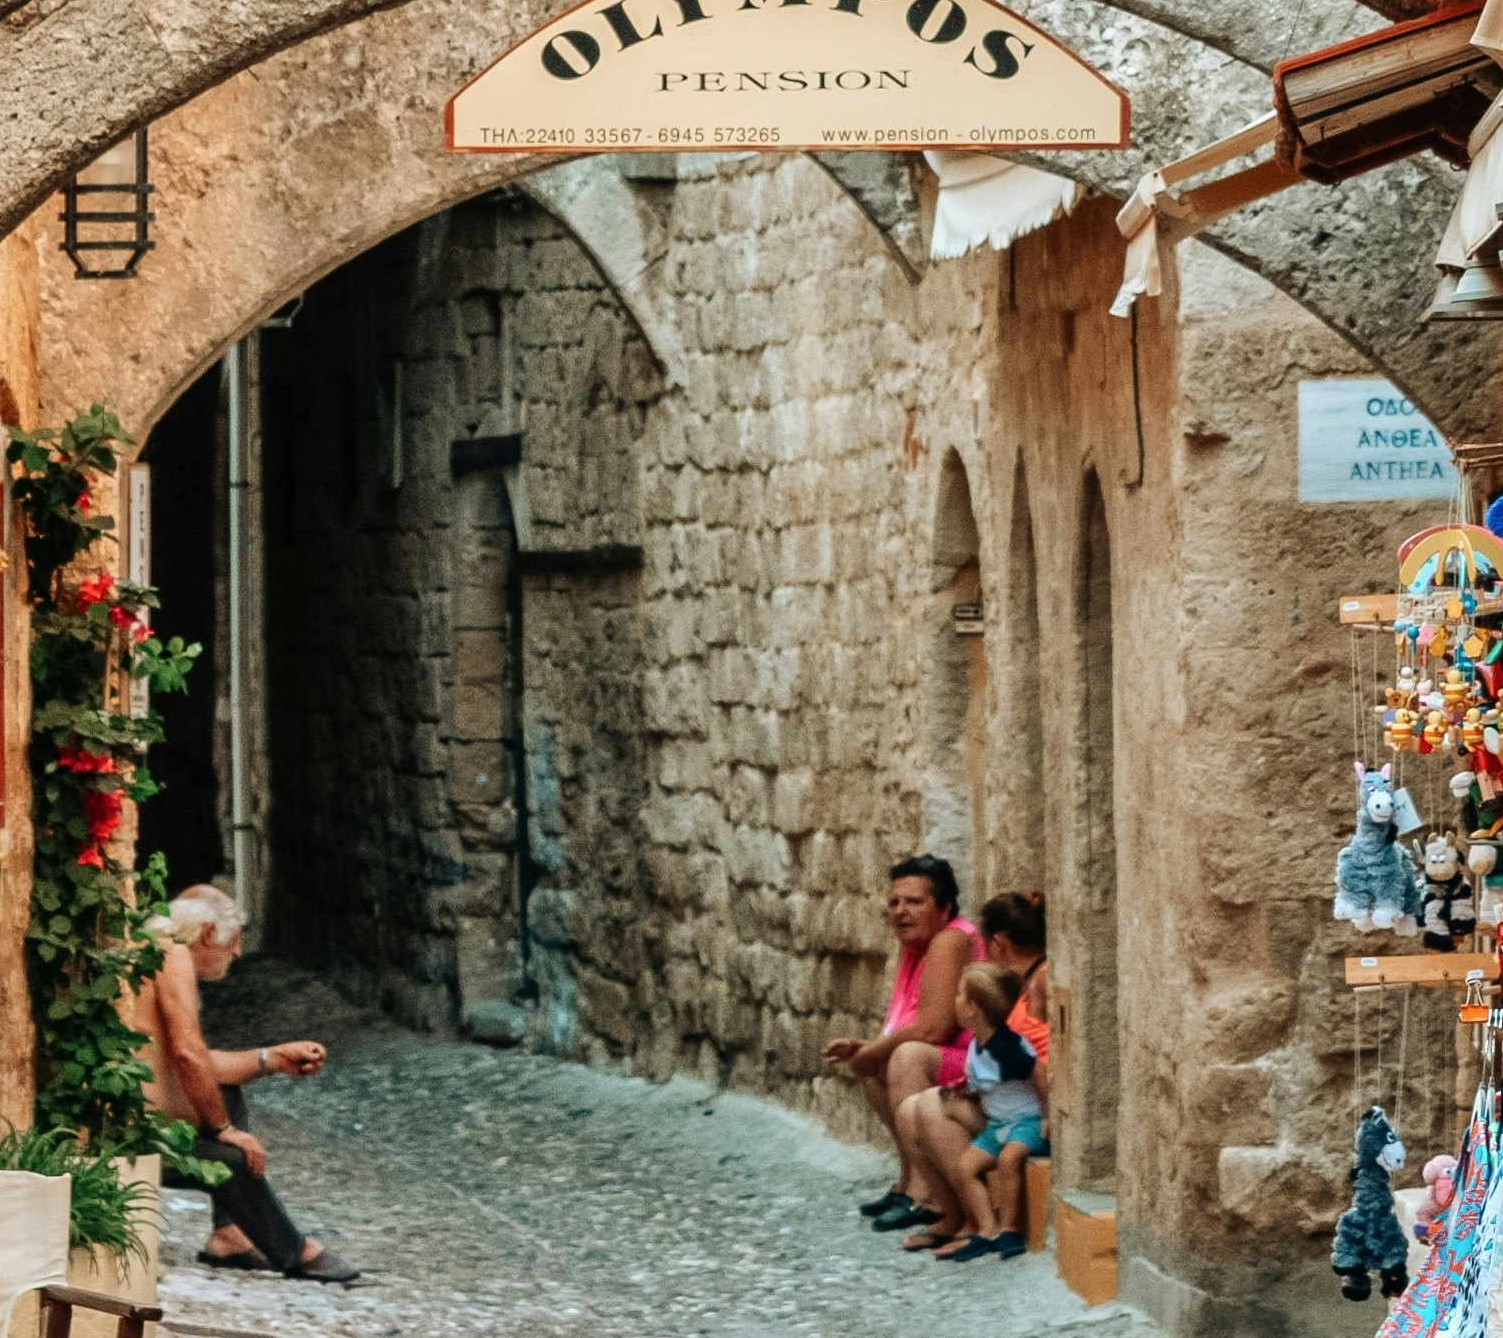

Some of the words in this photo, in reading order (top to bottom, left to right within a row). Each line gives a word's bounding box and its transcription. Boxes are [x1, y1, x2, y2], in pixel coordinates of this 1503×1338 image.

[656, 69, 913, 93] PENSION
[584, 127, 643, 144] 33567
[658, 127, 705, 144] 6945
[713, 126, 782, 143] 573265
[1357, 429, 1438, 448] ΑΝΘΕΑ
[1349, 461, 1443, 480] ANTHEA
